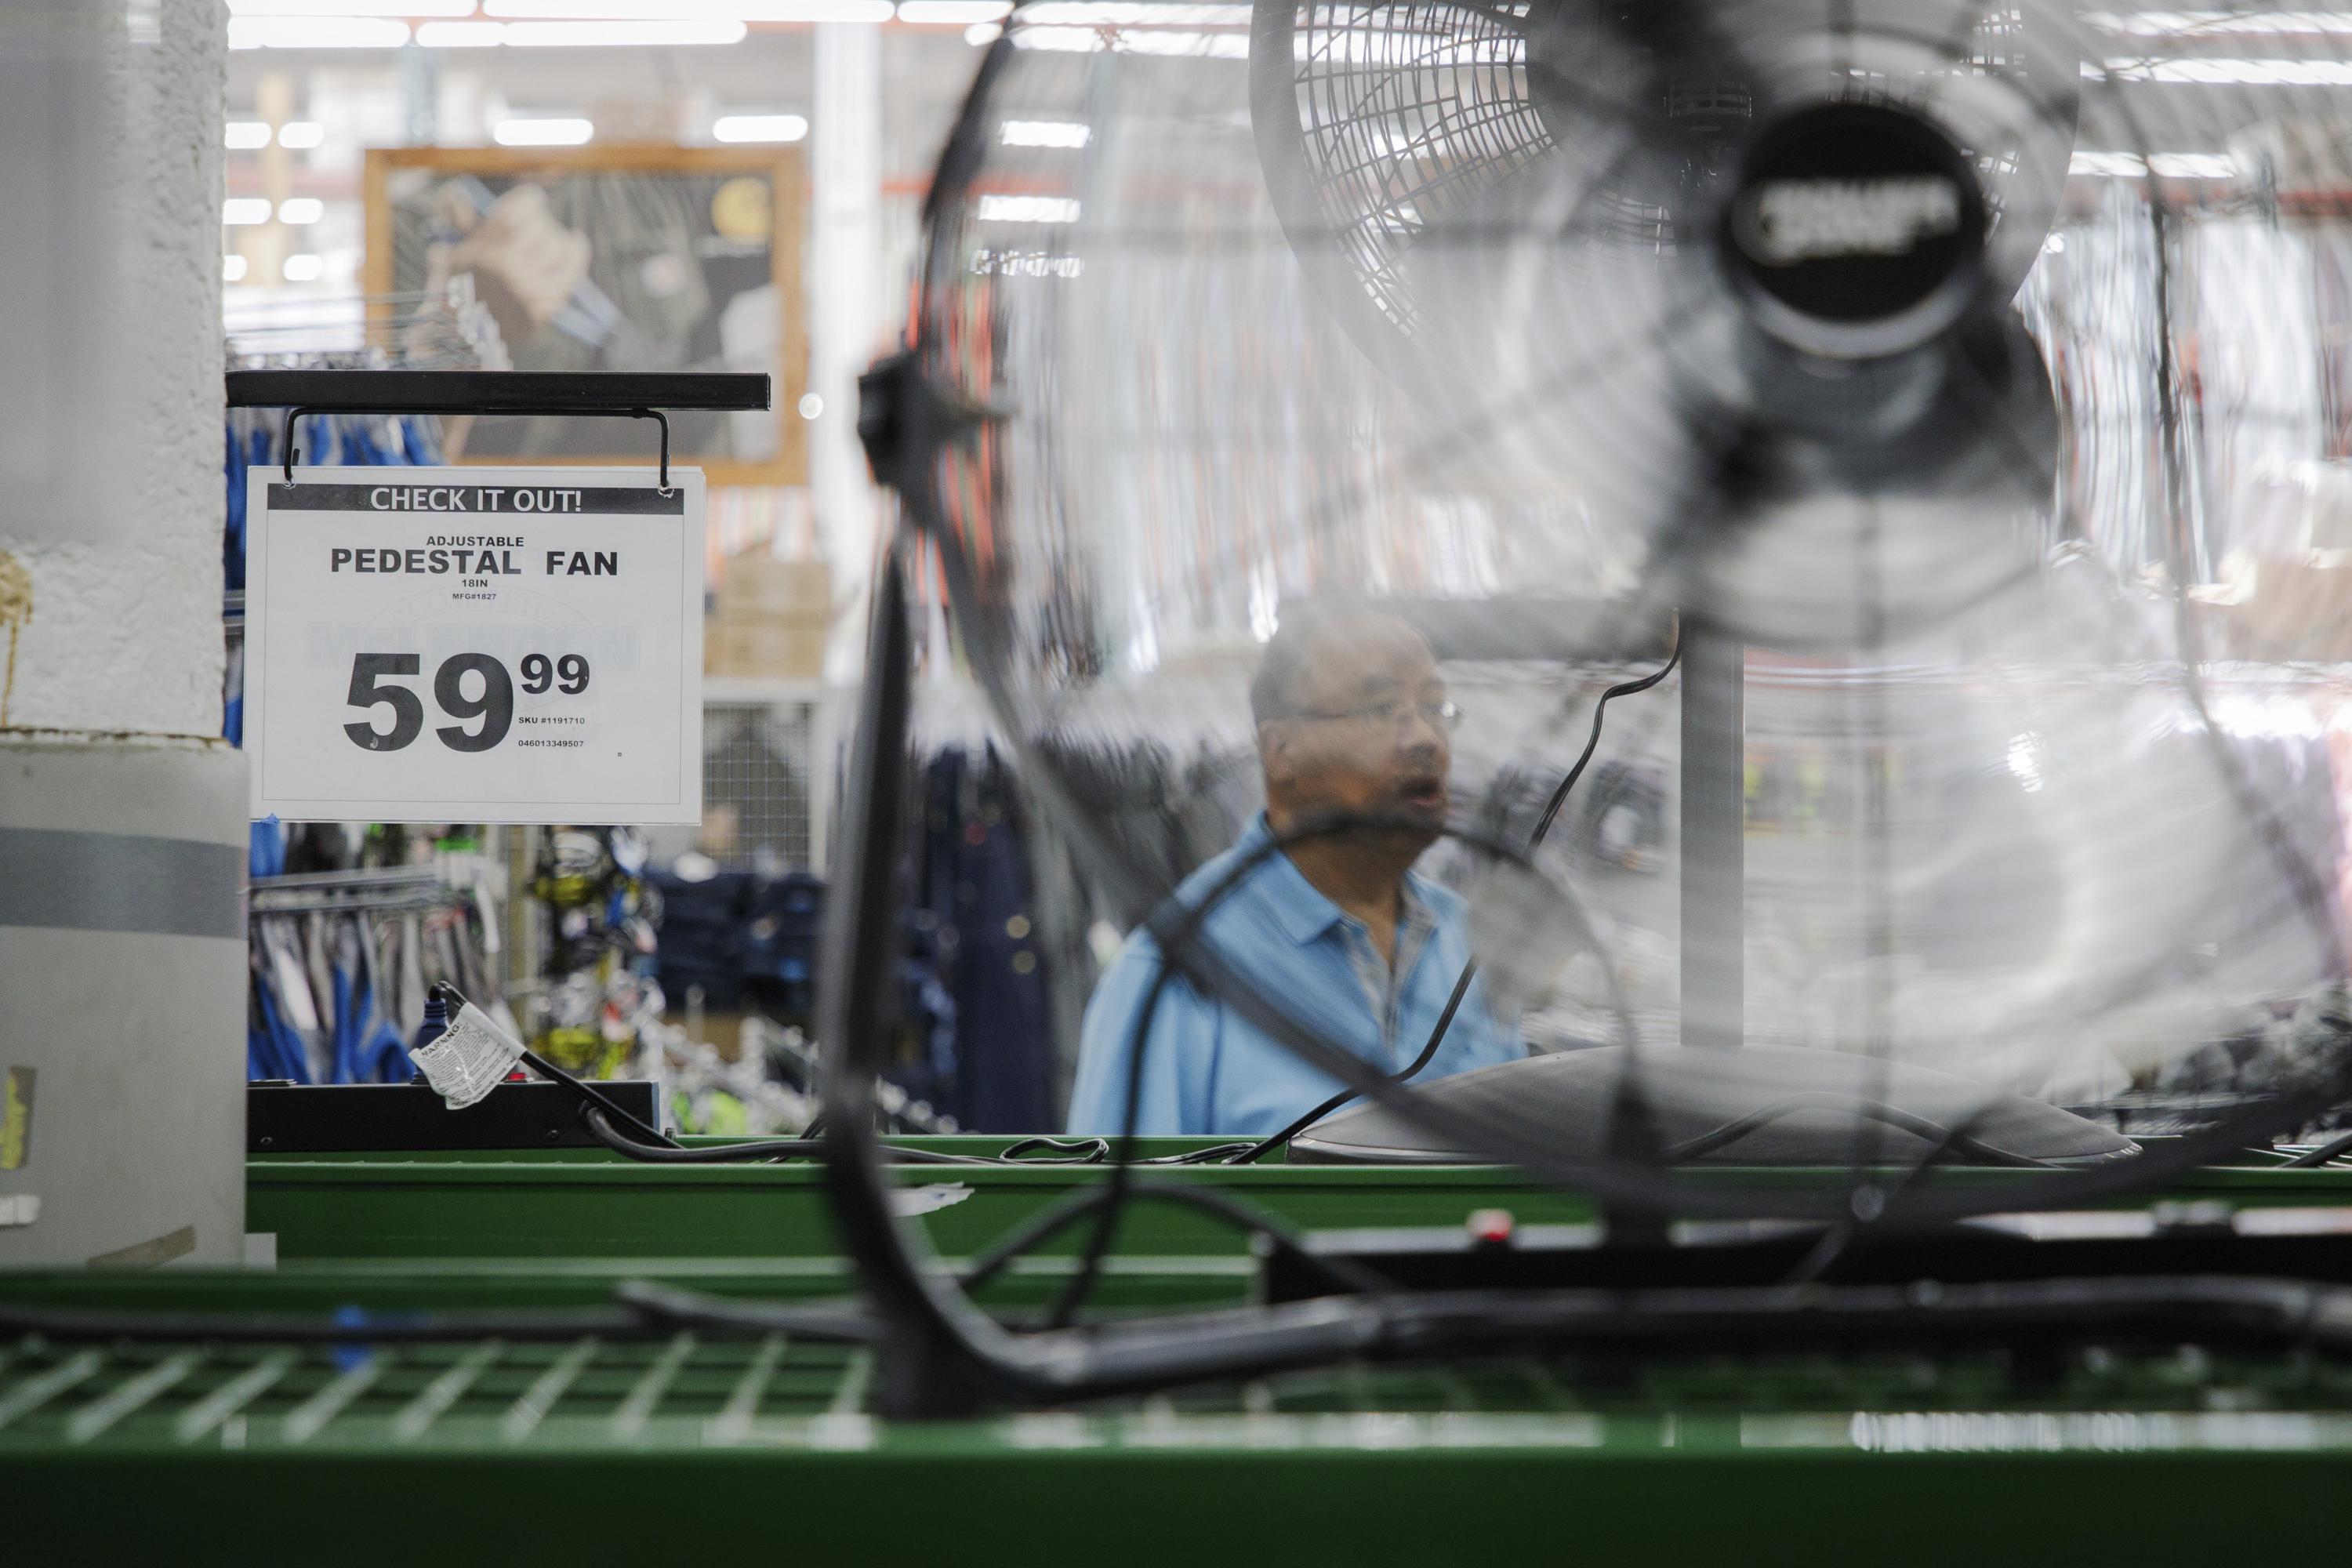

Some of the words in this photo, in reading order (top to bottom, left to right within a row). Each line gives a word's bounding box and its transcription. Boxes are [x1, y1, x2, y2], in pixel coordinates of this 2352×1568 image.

[370, 488, 466, 511] CHECK
[476, 488, 505, 511] IT
[514, 488, 582, 512] OUT!
[426, 535, 524, 547] ADJUSTABLE
[331, 548, 521, 575] PEDESTAL
[546, 550, 618, 576] FAN
[462, 579, 488, 588] 18IN
[343, 652, 514, 753] 59
[520, 653, 590, 695] 99
